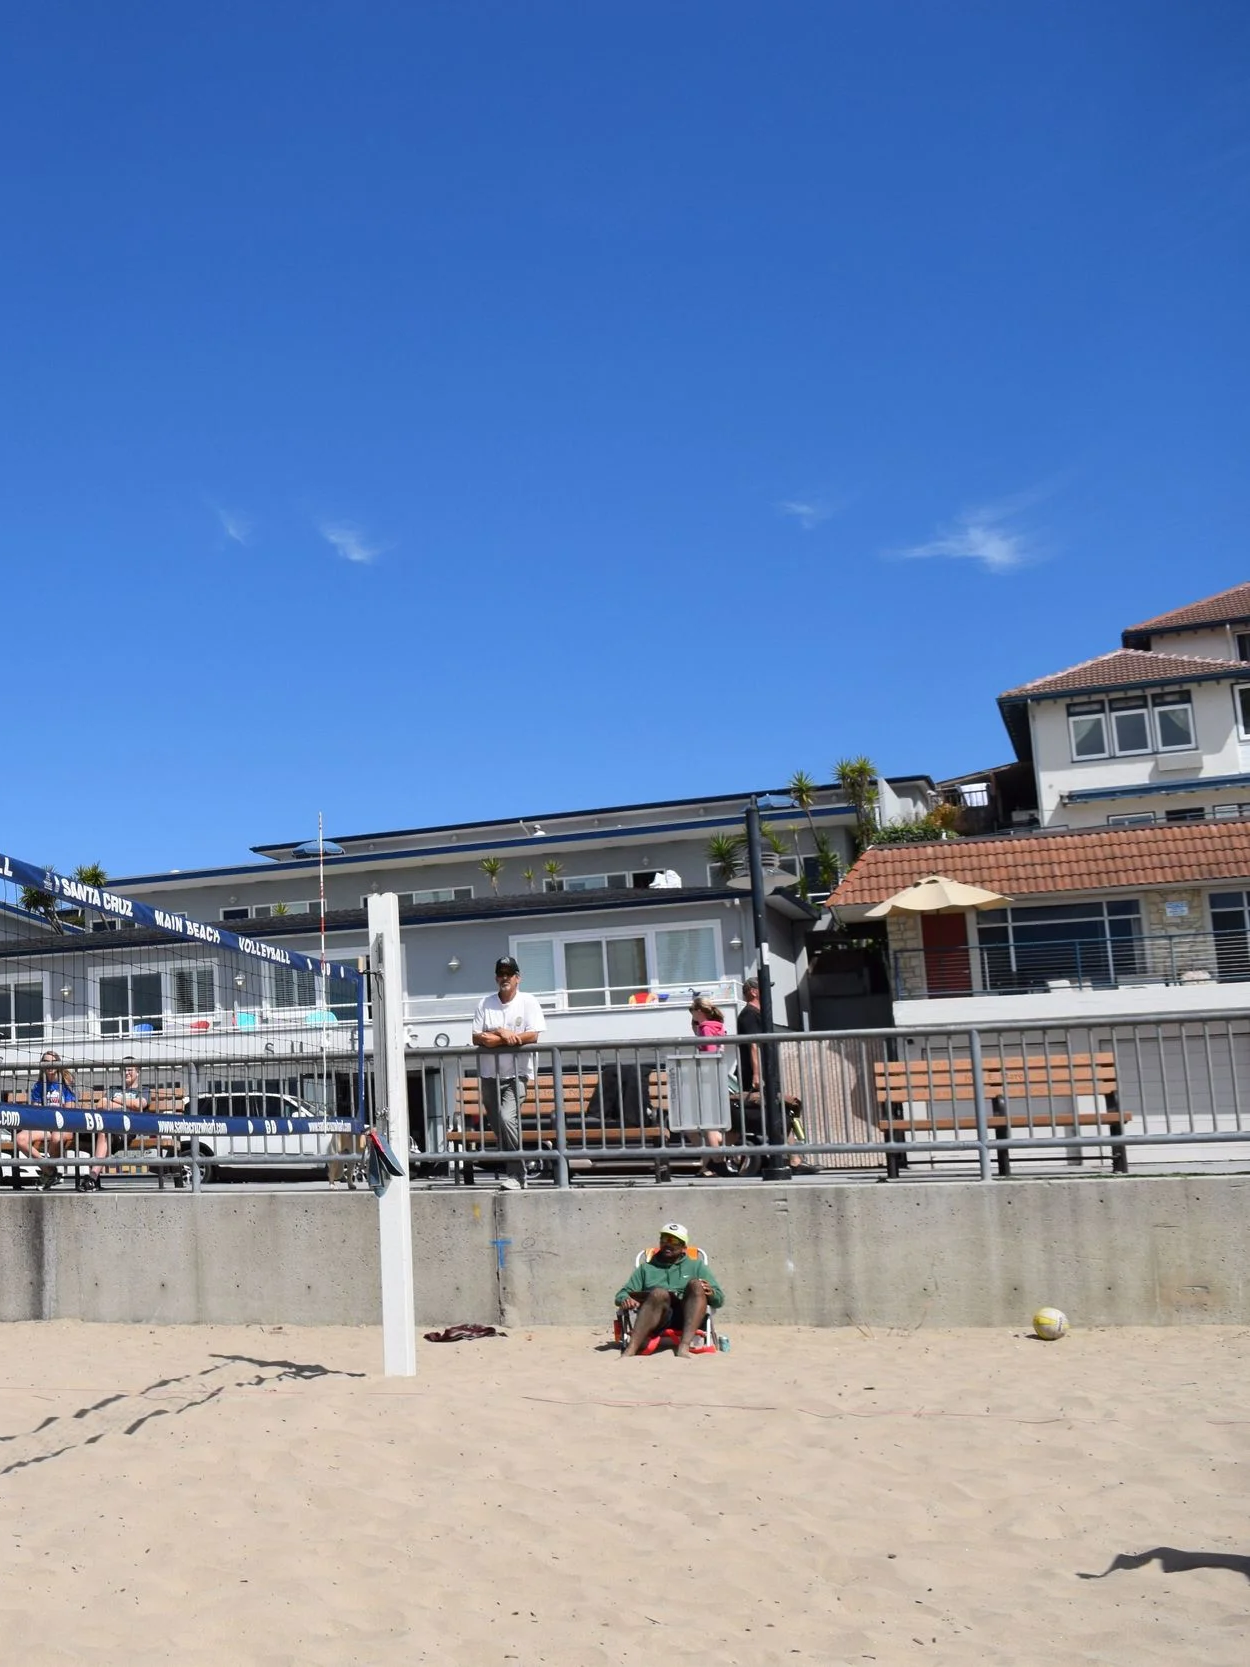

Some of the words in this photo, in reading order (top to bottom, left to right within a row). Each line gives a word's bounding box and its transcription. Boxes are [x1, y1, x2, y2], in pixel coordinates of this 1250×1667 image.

[61, 878, 101, 907] SANTA
[103, 892, 133, 917] CRUZ
[154, 909, 183, 933] MAIN
[185, 919, 220, 944] BEACH
[238, 936, 291, 965] VOLLEYBALL
